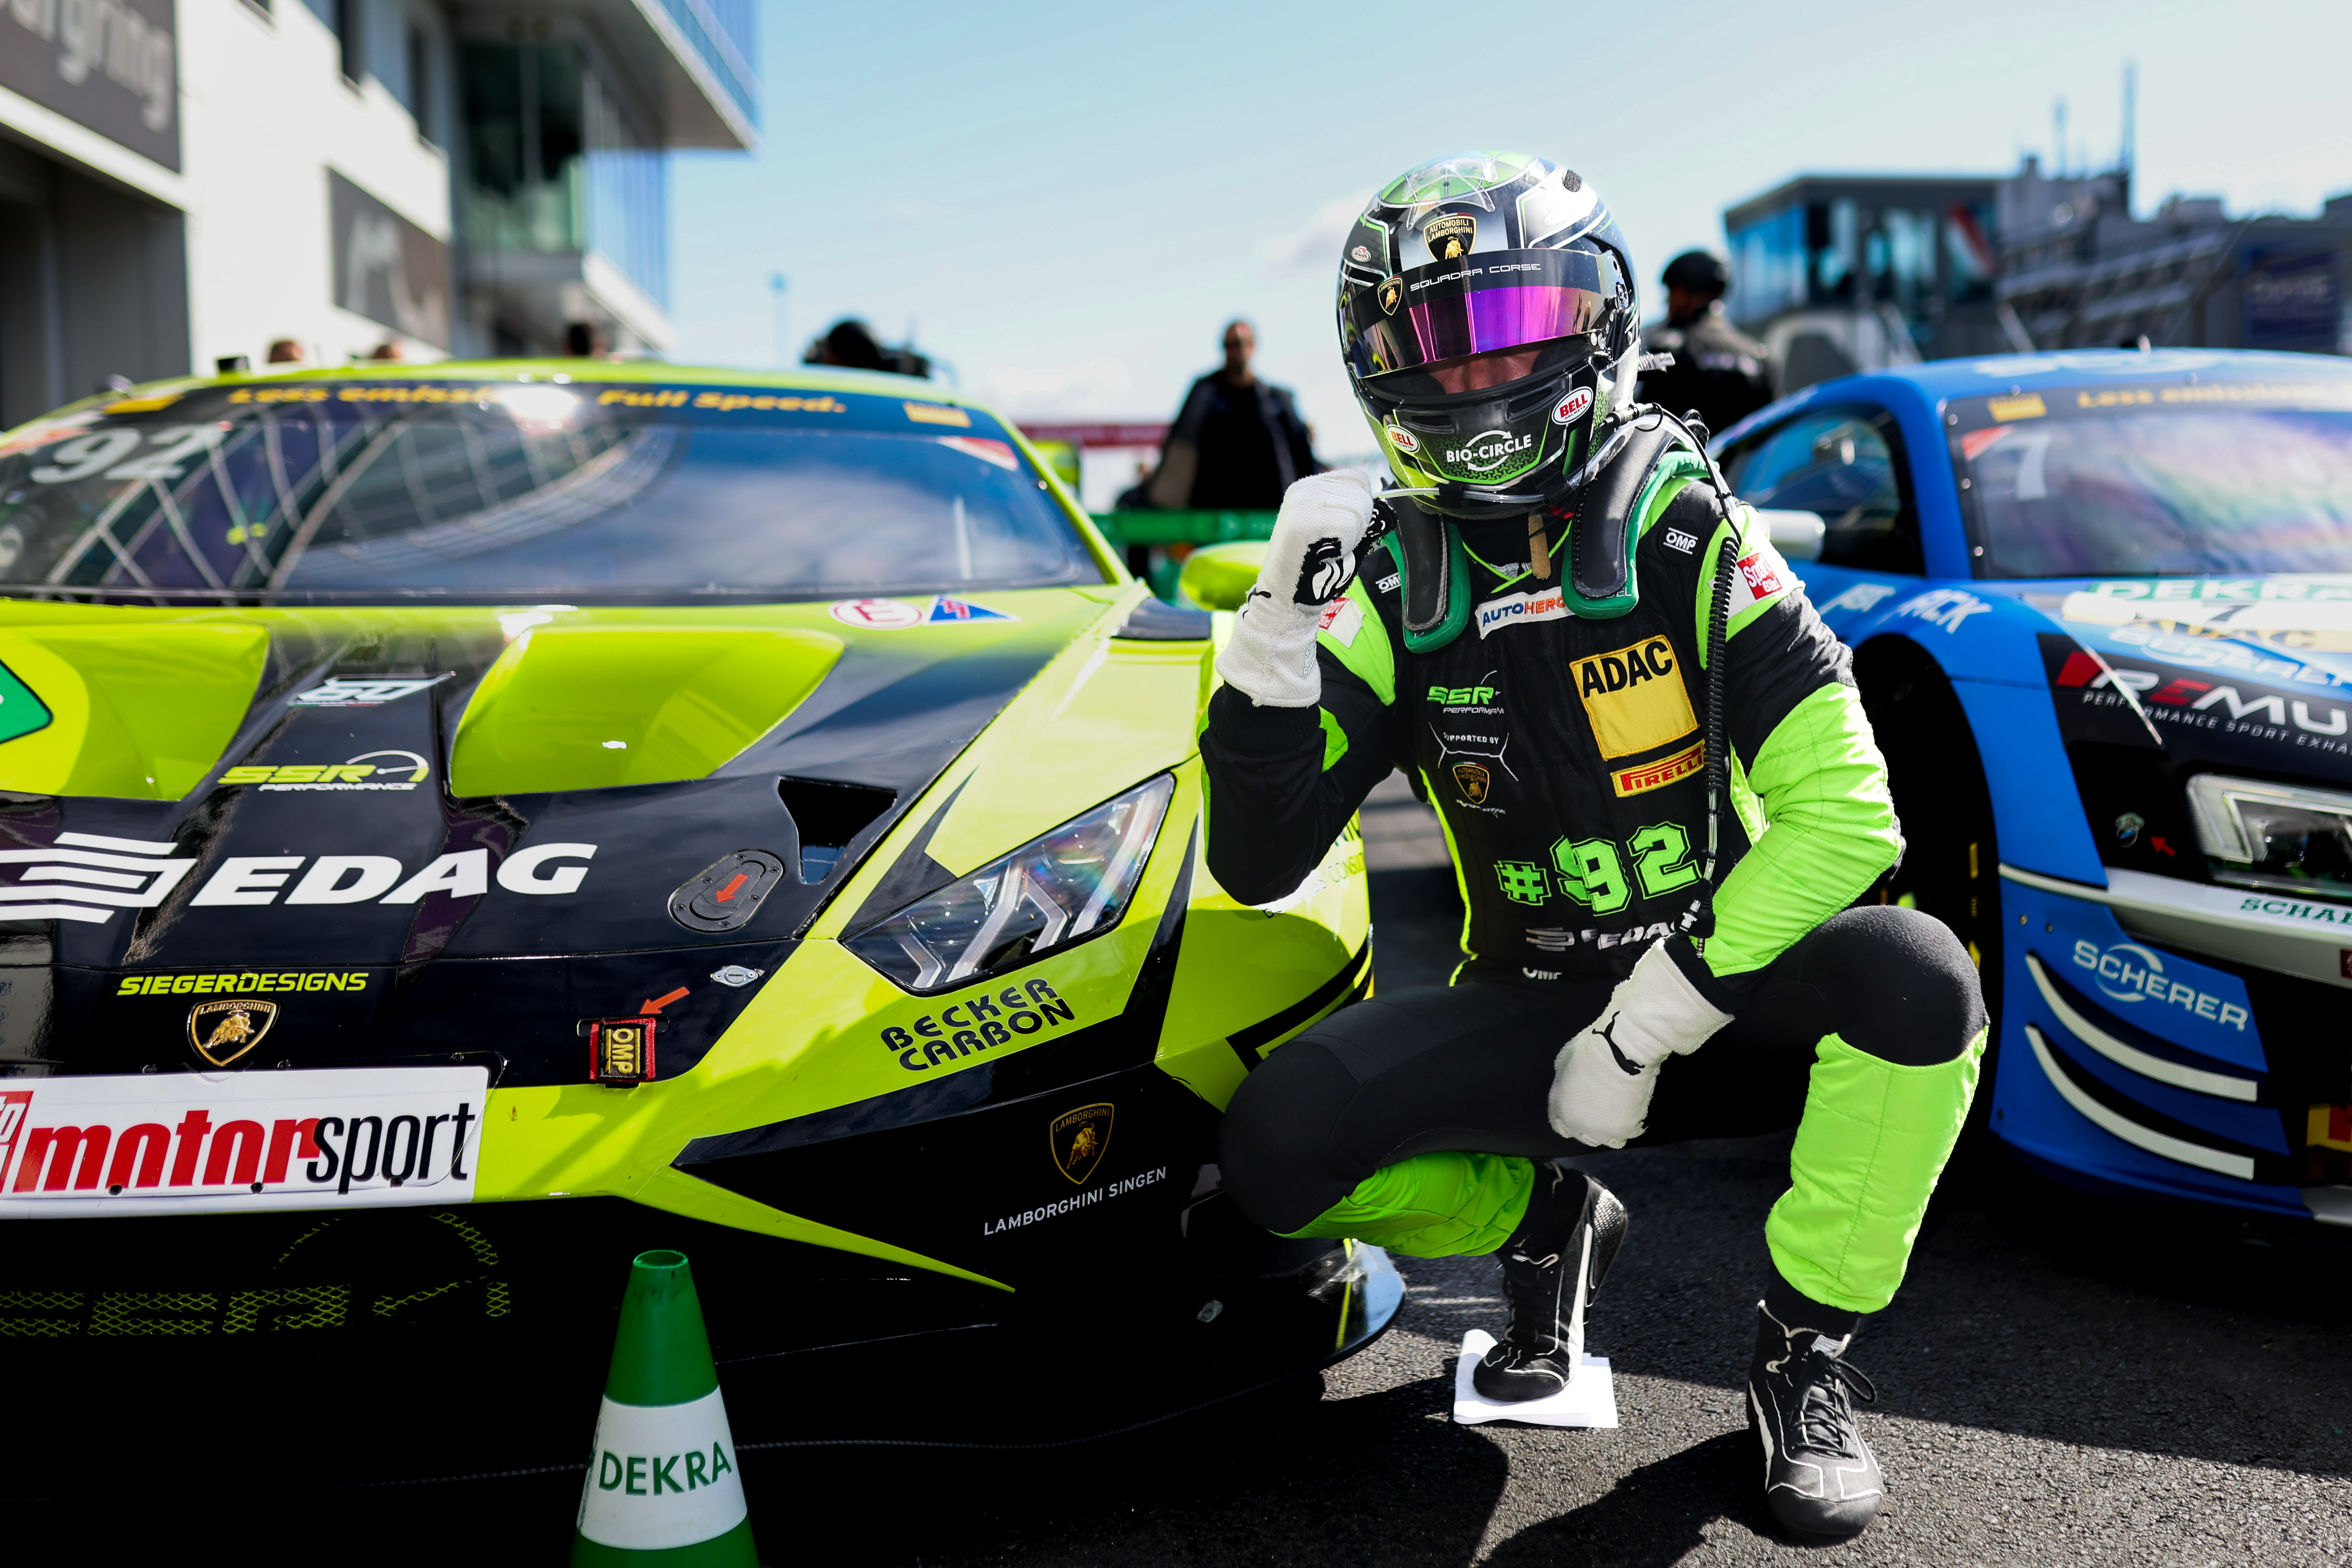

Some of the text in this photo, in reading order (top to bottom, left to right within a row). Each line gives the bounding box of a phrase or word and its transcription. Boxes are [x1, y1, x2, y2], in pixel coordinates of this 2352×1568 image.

[1428, 226, 1473, 243] LAMBORGHINI
[1429, 219, 1469, 234] AUTOMOBILI
[1379, 280, 1401, 293] LAMBORGHINI
[1410, 264, 1542, 292] SQUADRA CORSE
[1560, 394, 1588, 418] BELL
[1564, 405, 1586, 420] HELMETS
[1391, 431, 1414, 447] BELL
[1446, 434, 1532, 463] BIO-CIRCLE
[30, 422, 226, 484] 92
[1997, 434, 2050, 502] 7
[1666, 532, 1696, 550] OMP
[1378, 574, 1401, 591] OM
[1582, 640, 1672, 698] ADAC
[1427, 686, 1494, 705] SSR
[2225, 720, 2290, 743] SPORT
[2295, 733, 2352, 755] EXHA
[217, 765, 377, 783] SSR
[1620, 748, 1703, 791] PIRELLI
[258, 782, 418, 792] PERFORMANCE
[190, 843, 598, 907] EDAG
[116, 973, 369, 996] SIEGERDESIGNS
[2073, 940, 2249, 1031] SCHERER
[199, 1002, 271, 1015] LAMBORGHINI
[880, 978, 1058, 1052] BECKER
[899, 998, 1075, 1071] CARBON
[612, 1028, 634, 1074] OMP
[1055, 1108, 1109, 1133] LAMBORGHINI
[984, 1167, 1167, 1236] LAMBORGHINI SINGEN
[598, 1441, 733, 1497] DEKRA
